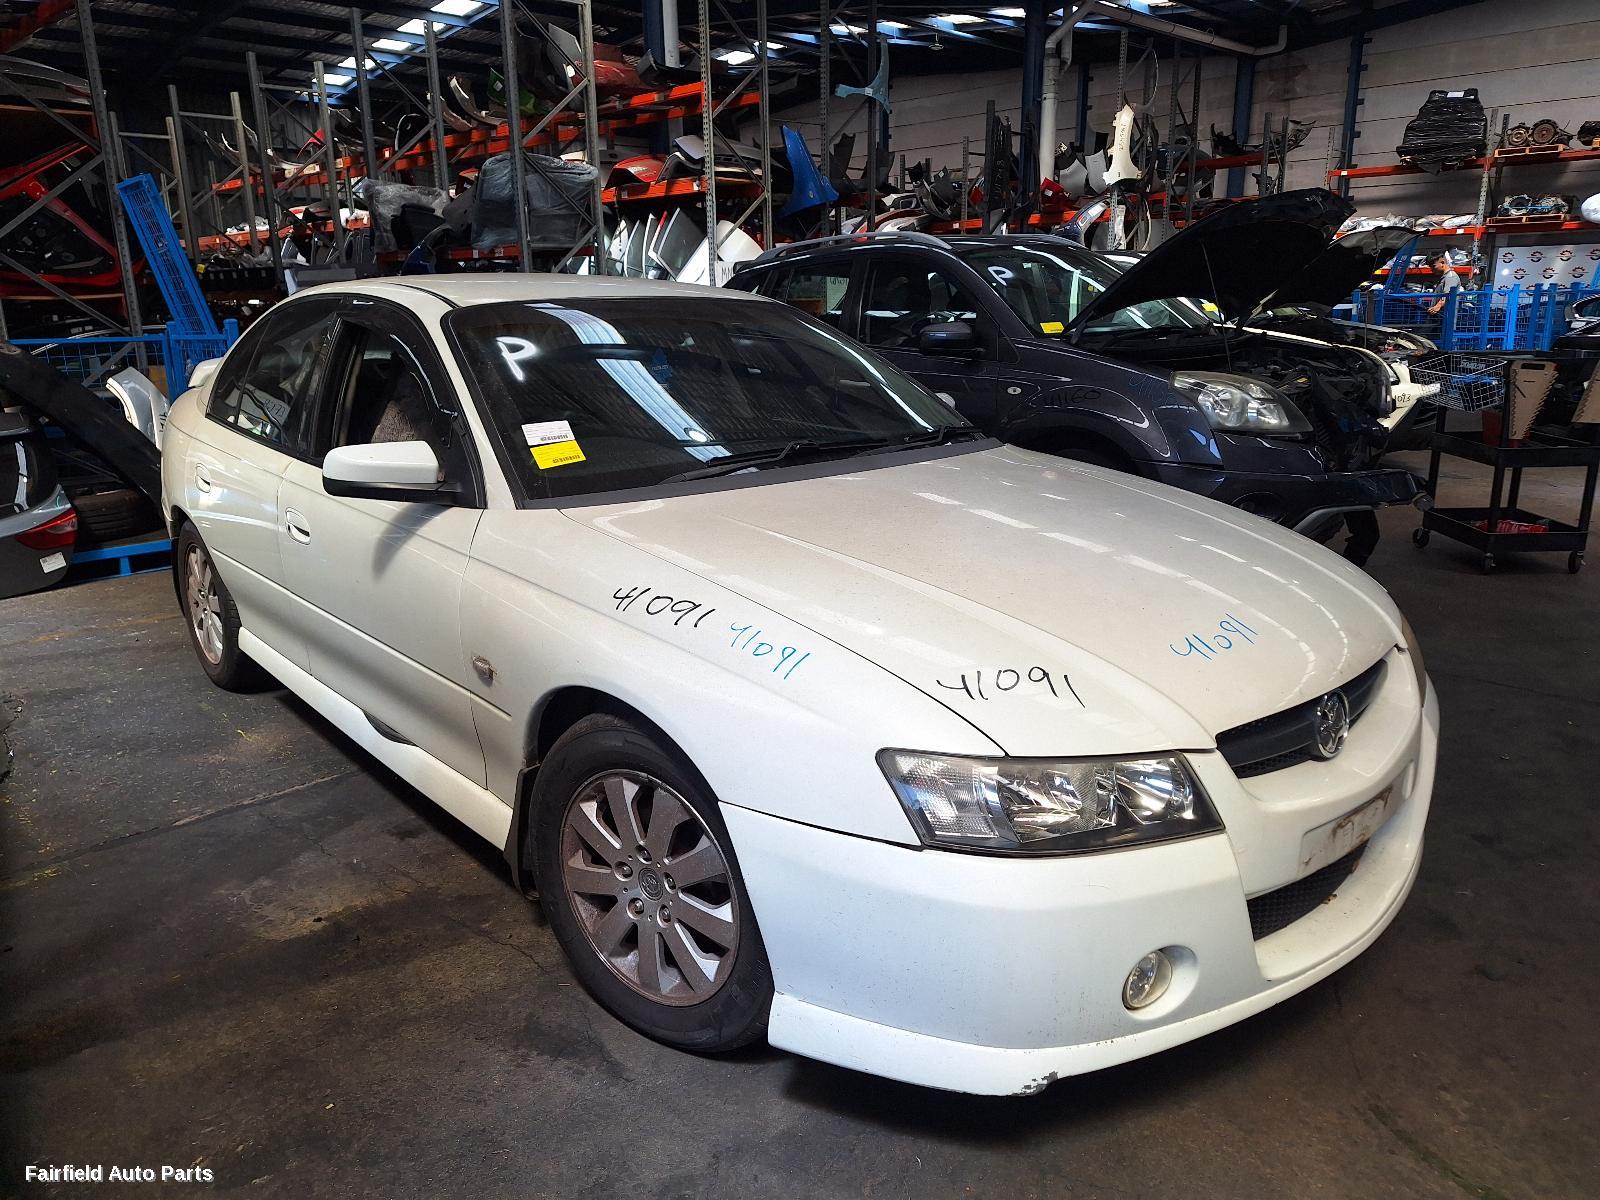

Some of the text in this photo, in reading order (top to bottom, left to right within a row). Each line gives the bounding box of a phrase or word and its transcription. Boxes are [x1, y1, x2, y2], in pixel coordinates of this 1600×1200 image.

[987, 265, 1014, 285] P
[495, 336, 538, 382] P
[613, 586, 716, 629] 41091
[730, 621, 812, 681] 41091
[1169, 612, 1259, 663] 41091
[936, 666, 1087, 709] 41091
